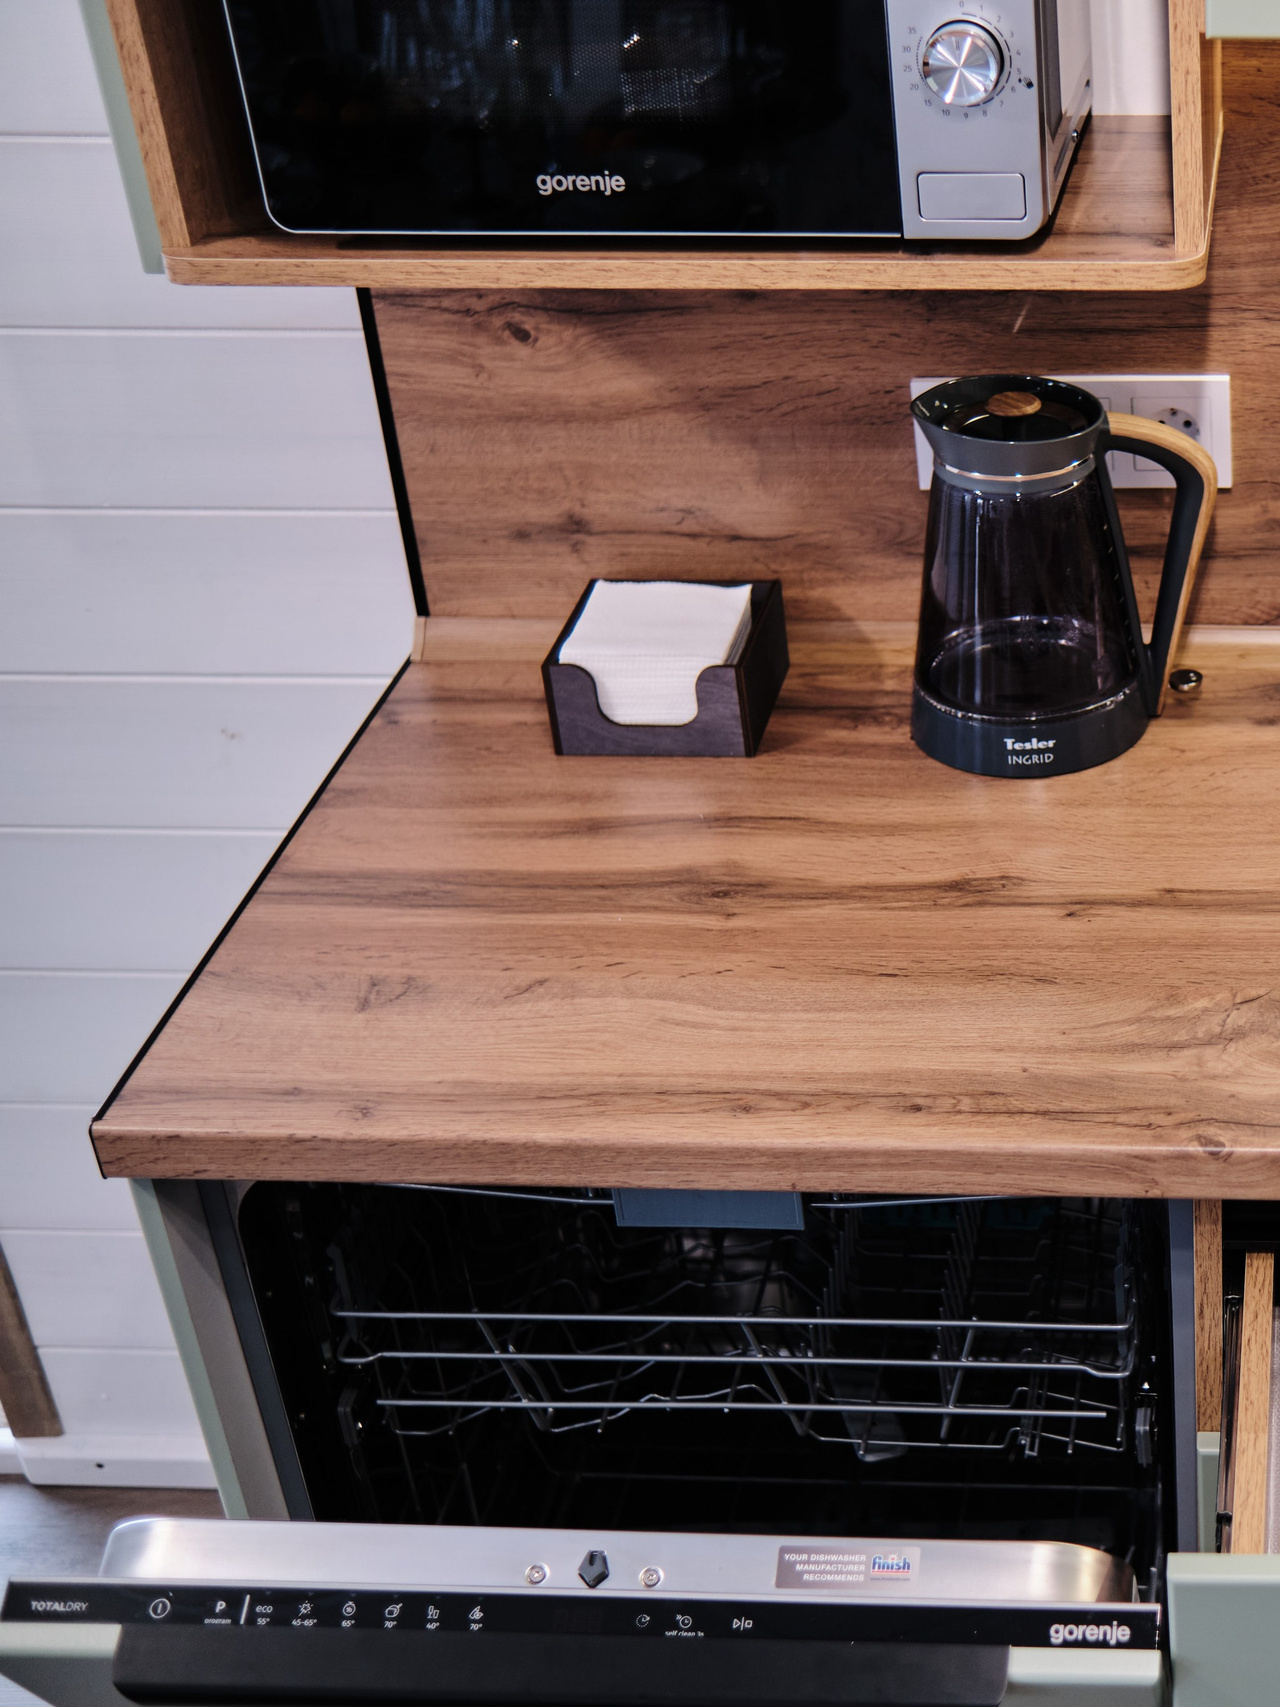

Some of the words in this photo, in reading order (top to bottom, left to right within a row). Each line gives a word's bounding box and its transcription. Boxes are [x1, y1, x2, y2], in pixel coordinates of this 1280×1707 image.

[910, 83, 919, 91] 20
[536, 170, 626, 196] gorenje
[1003, 738, 1056, 750] Tesler
[1008, 753, 1054, 765] INGRID
[784, 1553, 808, 1561] YOUR
[871, 1554, 911, 1571] finish
[795, 1563, 866, 1571] MANUFACTURER
[803, 1573, 865, 1581] RECOMMENDS
[30, 1601, 88, 1611] TOTALDRY
[215, 1601, 226, 1613] P
[255, 1605, 273, 1613] eco
[341, 1619, 355, 1627] 65°
[384, 1620, 397, 1628] 70°
[469, 1622, 483, 1630] 70°
[1050, 1620, 1131, 1646] gorenje
